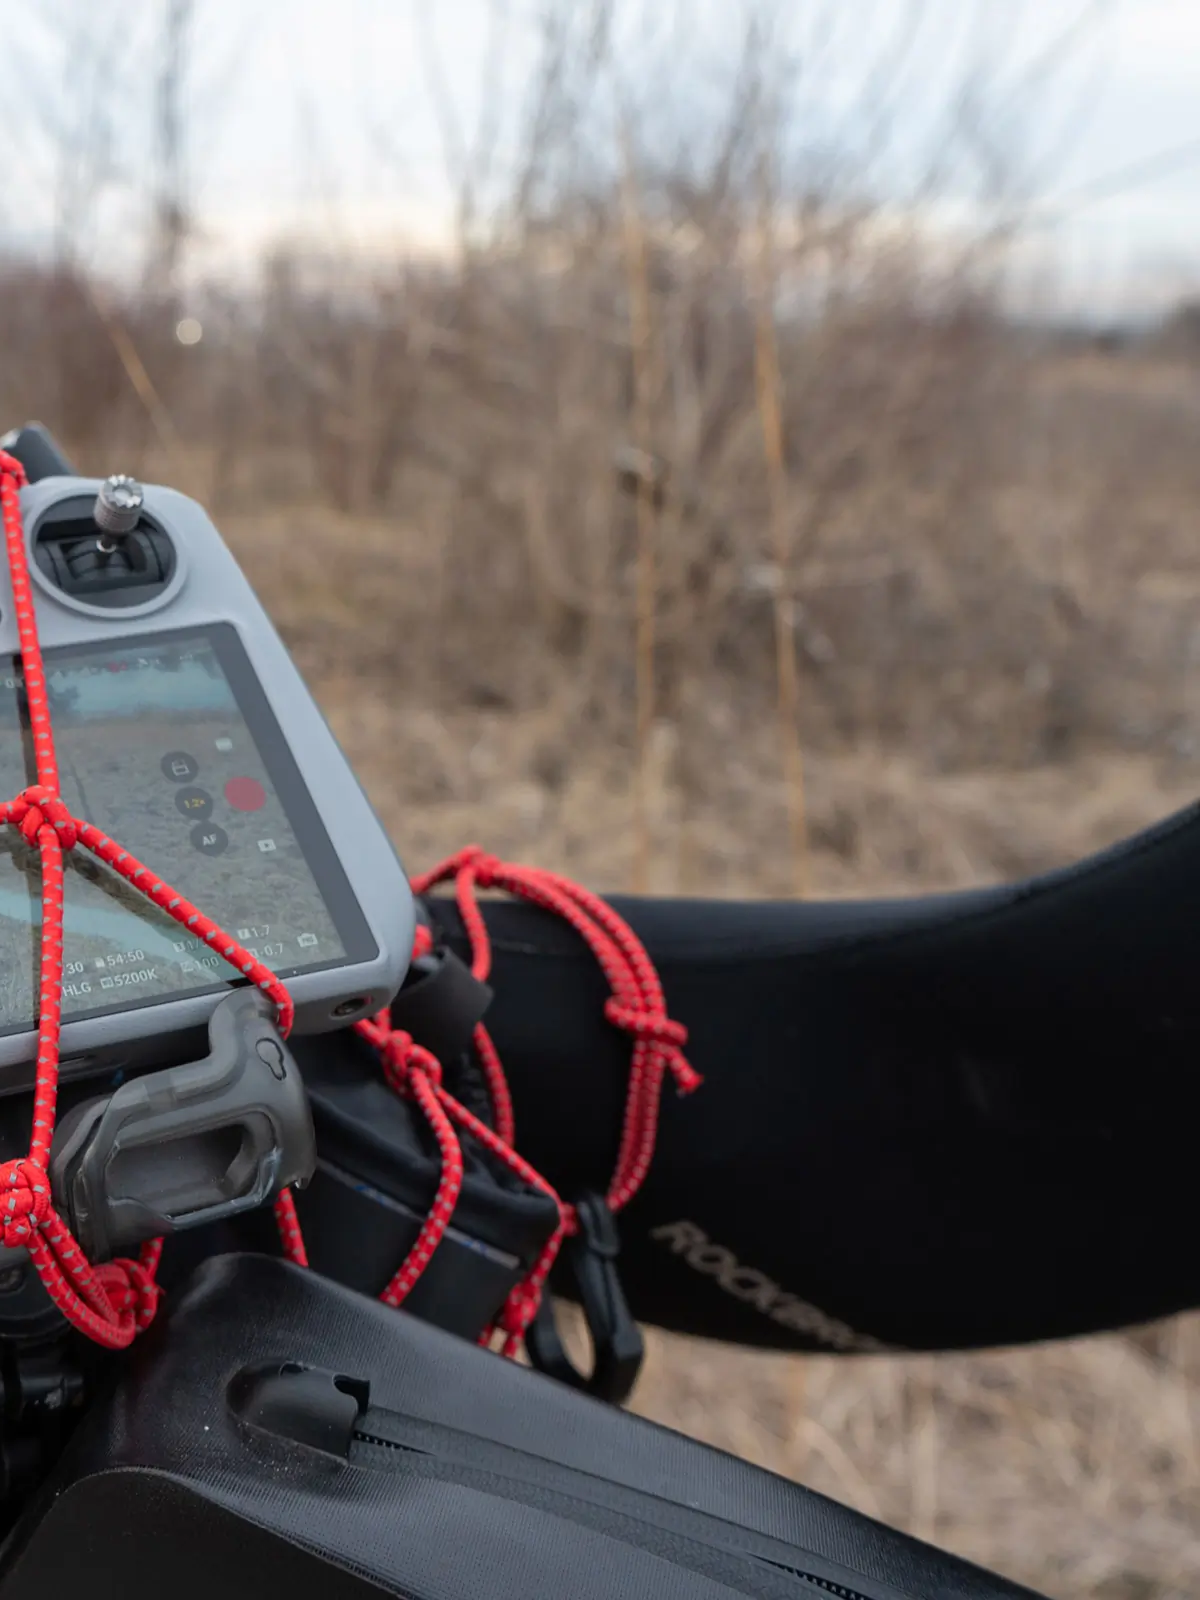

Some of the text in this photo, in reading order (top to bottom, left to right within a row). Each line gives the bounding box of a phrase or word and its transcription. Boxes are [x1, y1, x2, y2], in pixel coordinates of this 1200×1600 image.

[106, 949, 145, 967] 54:50
[196, 956, 219, 970] 100
[114, 968, 158, 986] 5200K
[62, 981, 92, 997] HLG
